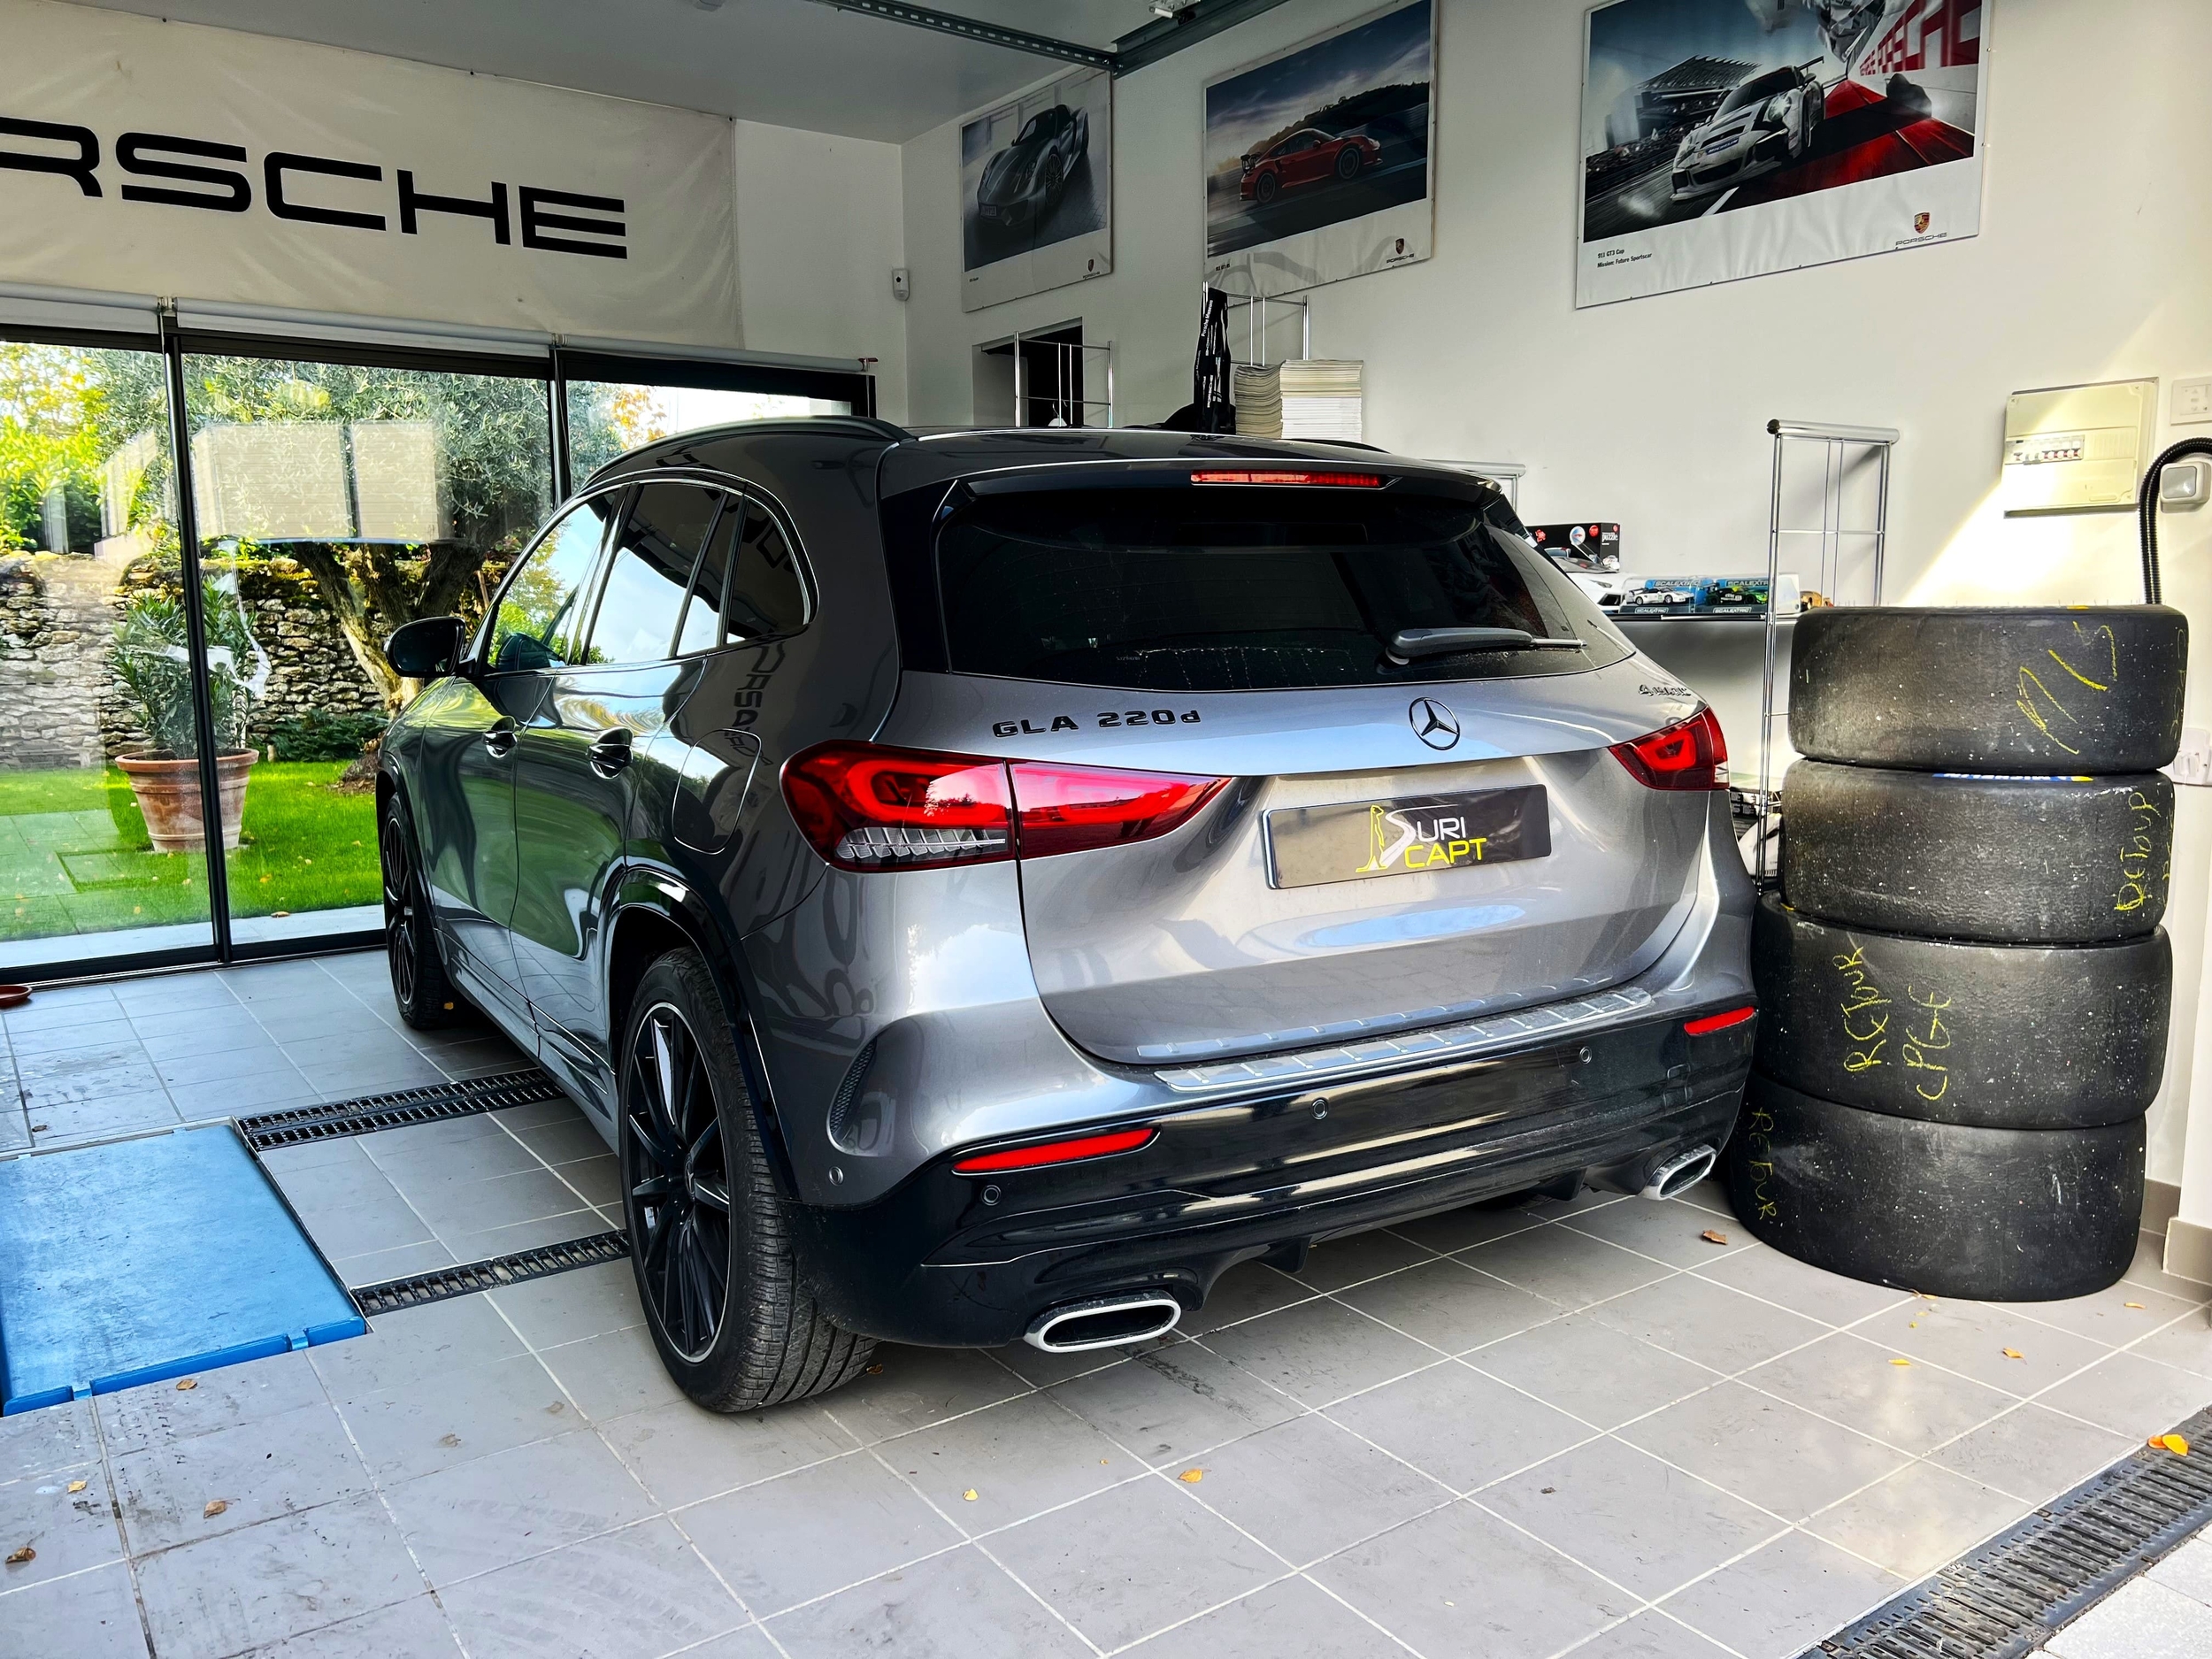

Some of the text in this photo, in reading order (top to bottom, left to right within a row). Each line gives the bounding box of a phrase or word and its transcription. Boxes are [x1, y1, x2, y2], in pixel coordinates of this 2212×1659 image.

[1895, 232, 1947, 246] PORSCHE
[1631, 253, 1652, 262] Sportscar
[1201, 319, 1210, 337] Porsche
[992, 715, 1079, 737] GLA
[1404, 838, 1486, 868] CAPT
